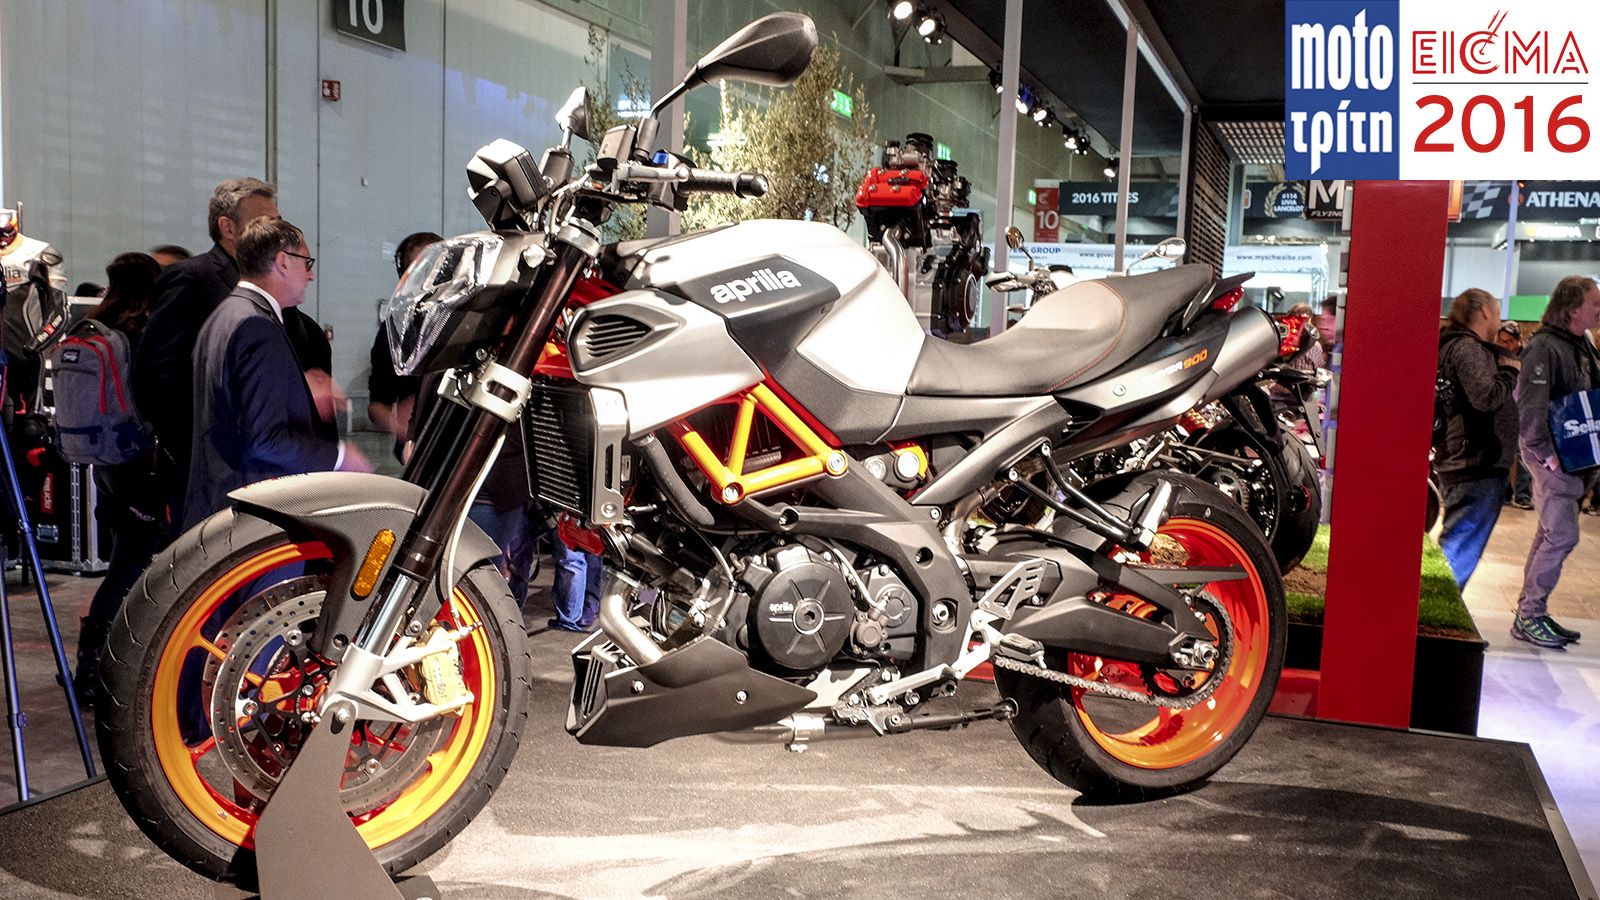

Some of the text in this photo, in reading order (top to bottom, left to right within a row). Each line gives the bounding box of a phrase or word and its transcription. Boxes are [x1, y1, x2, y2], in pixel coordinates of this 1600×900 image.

[349, 0, 384, 35] 10
[1072, 192, 1140, 204] 2016 TITES
[1526, 191, 1600, 208] ATHENA
[1036, 210, 1060, 230] 10
[1031, 246, 1061, 254] GROUP
[709, 267, 802, 304] aprilia
[769, 601, 795, 614] aprilia
